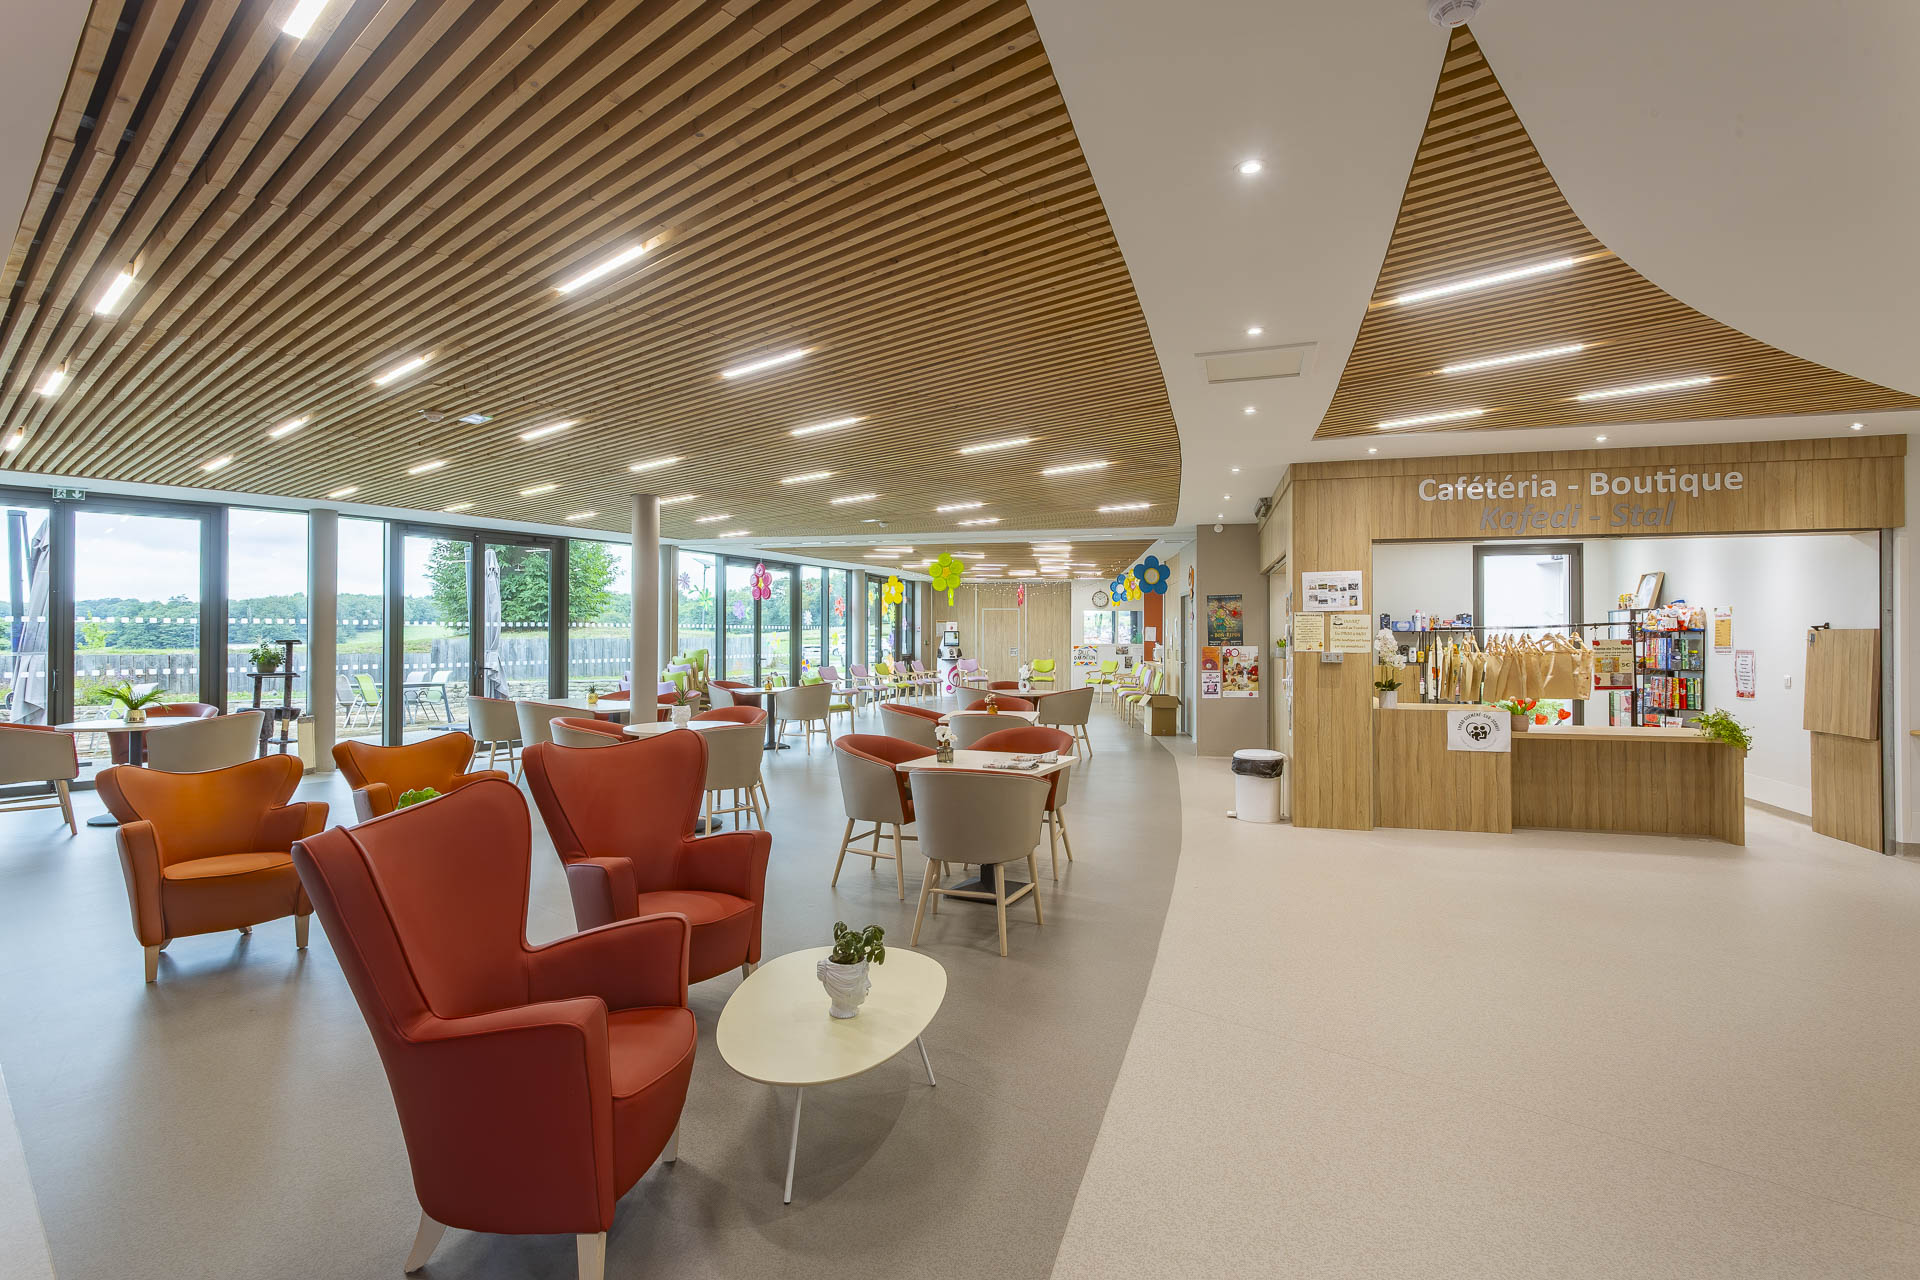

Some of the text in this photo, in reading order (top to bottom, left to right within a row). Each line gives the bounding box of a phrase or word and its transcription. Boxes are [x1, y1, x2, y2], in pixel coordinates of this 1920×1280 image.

[1418, 474, 1557, 501] Cafétéria
[1589, 468, 1743, 498] Boutique
[1480, 504, 1582, 534] Kafedi
[1610, 500, 1676, 527] Stal
